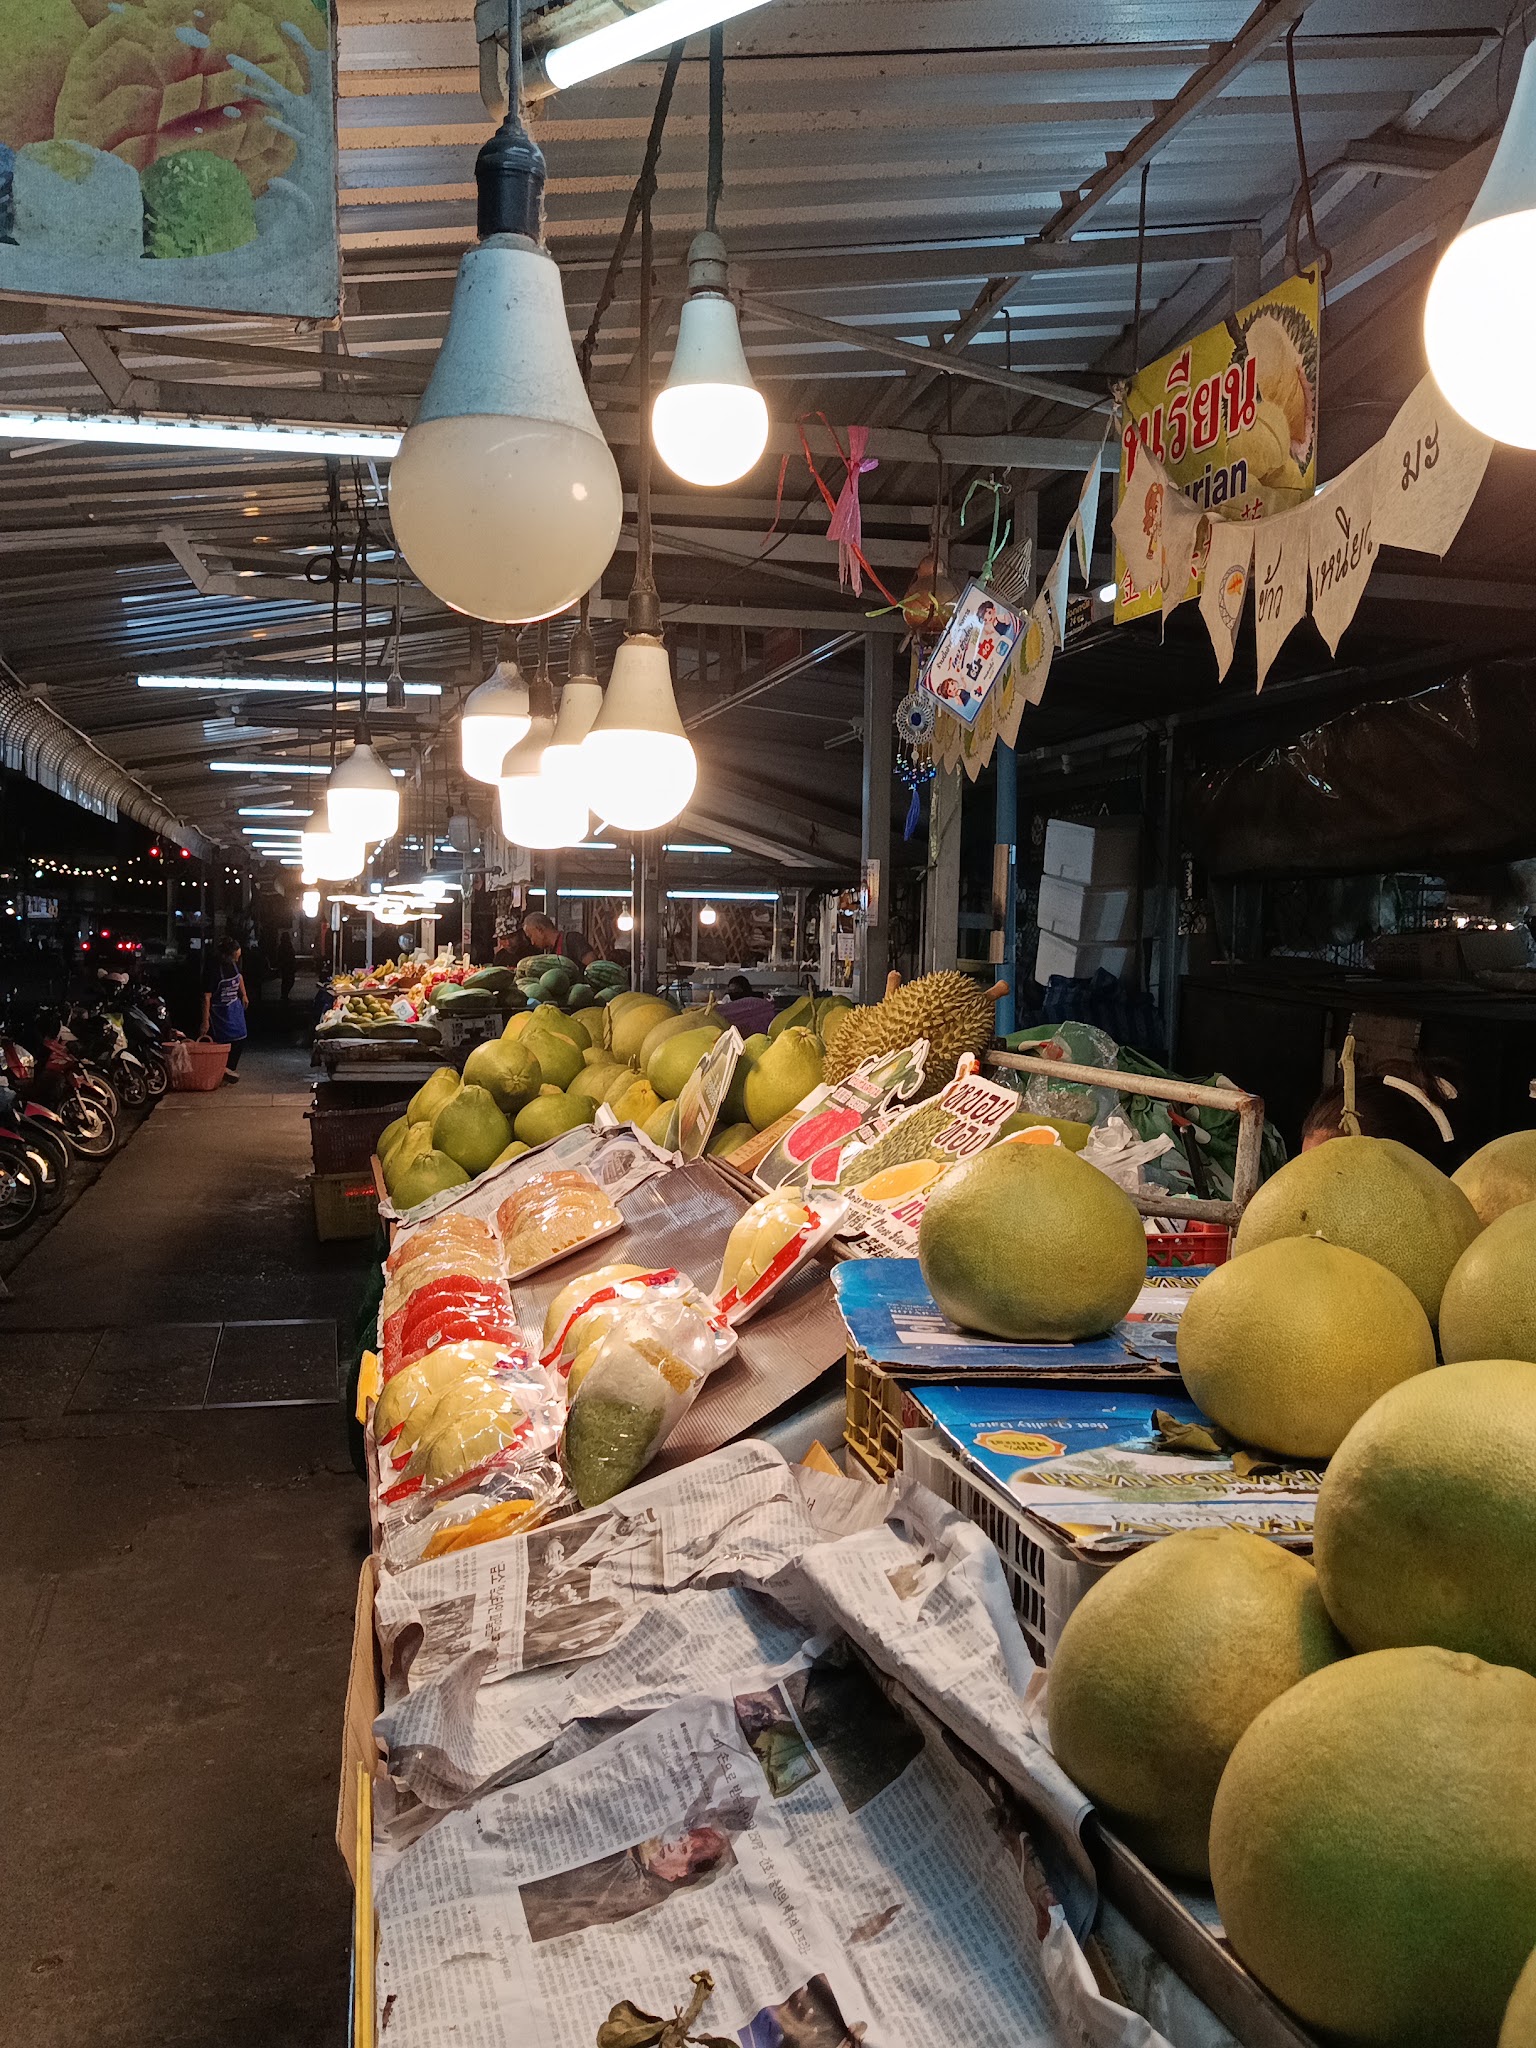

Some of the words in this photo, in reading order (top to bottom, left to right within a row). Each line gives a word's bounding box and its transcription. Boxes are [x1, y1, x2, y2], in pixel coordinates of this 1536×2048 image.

[1402, 420, 1439, 491] มะ
[1258, 541, 1284, 623] ข้าว
[943, 1083, 1016, 1126] หมอน
[934, 1119, 991, 1155] ทอง
[969, 1421, 1013, 1429] Dates
[1017, 1420, 1072, 1430] Quality
[1075, 1422, 1109, 1430] Best
